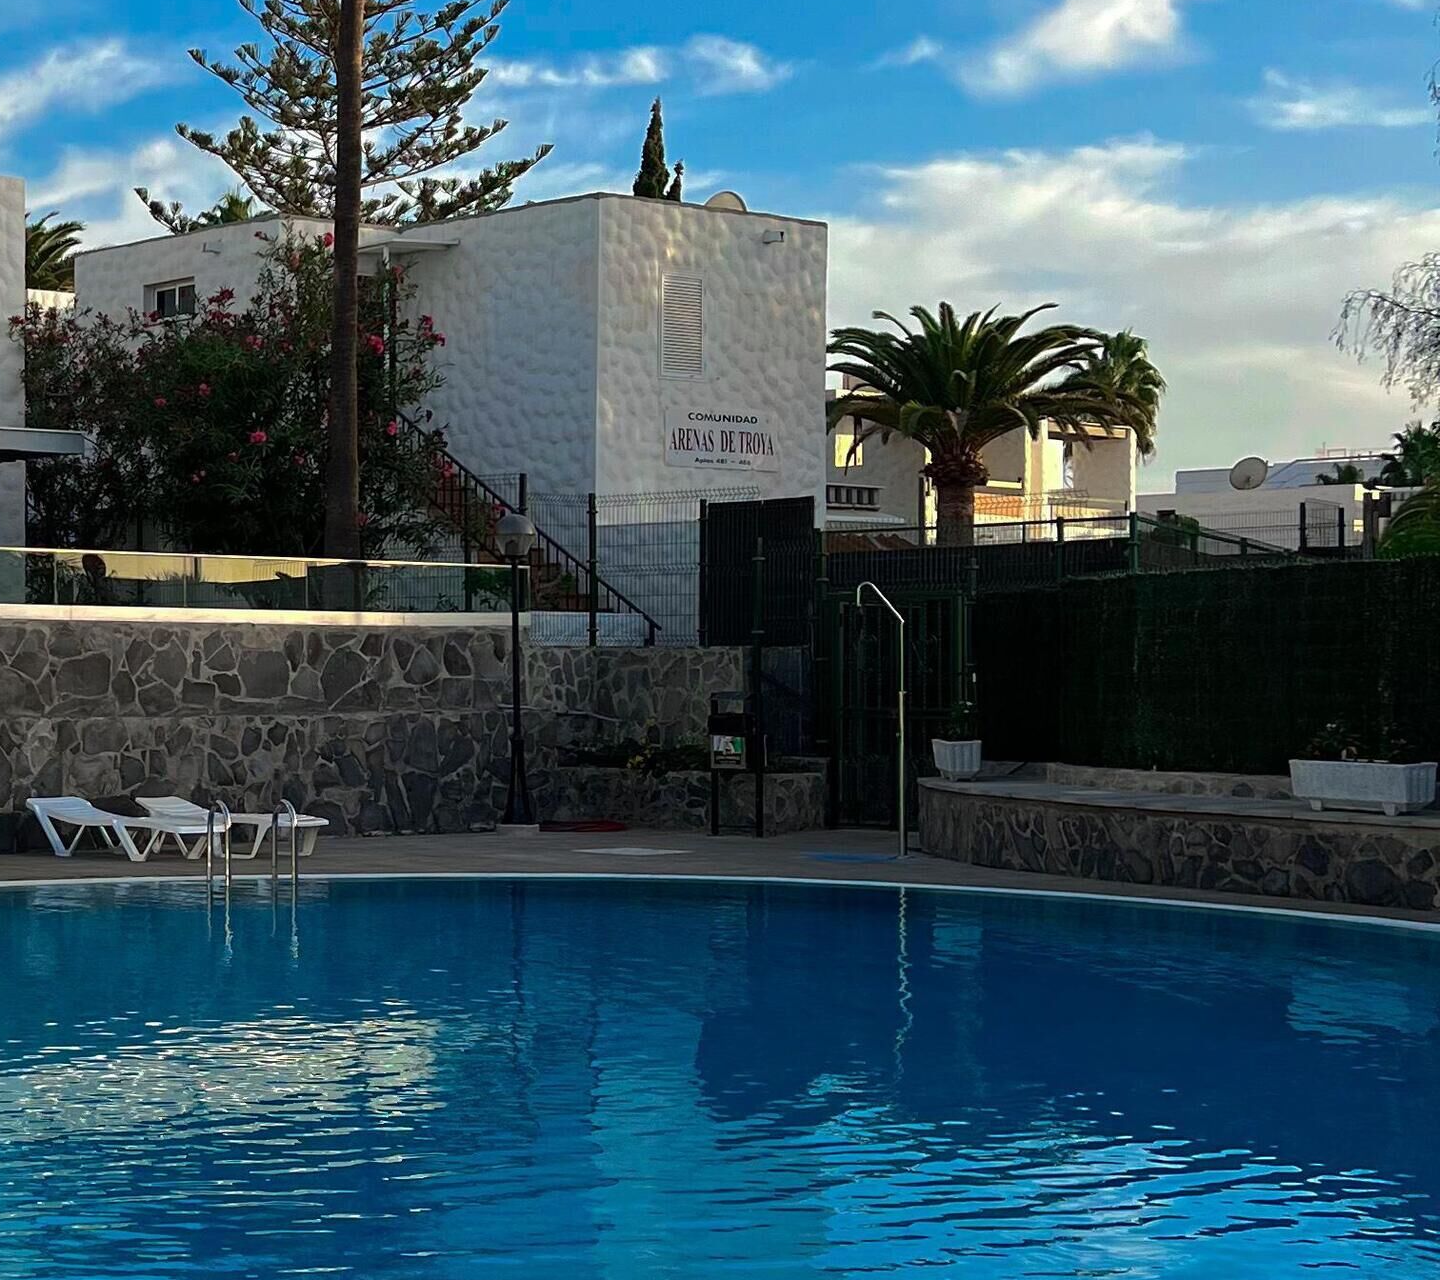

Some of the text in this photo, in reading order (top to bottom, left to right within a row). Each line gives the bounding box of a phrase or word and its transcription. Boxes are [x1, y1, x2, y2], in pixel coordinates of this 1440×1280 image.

[687, 412, 758, 424] COMUNIDAD
[669, 427, 774, 456] ARENAS DE TROYA
